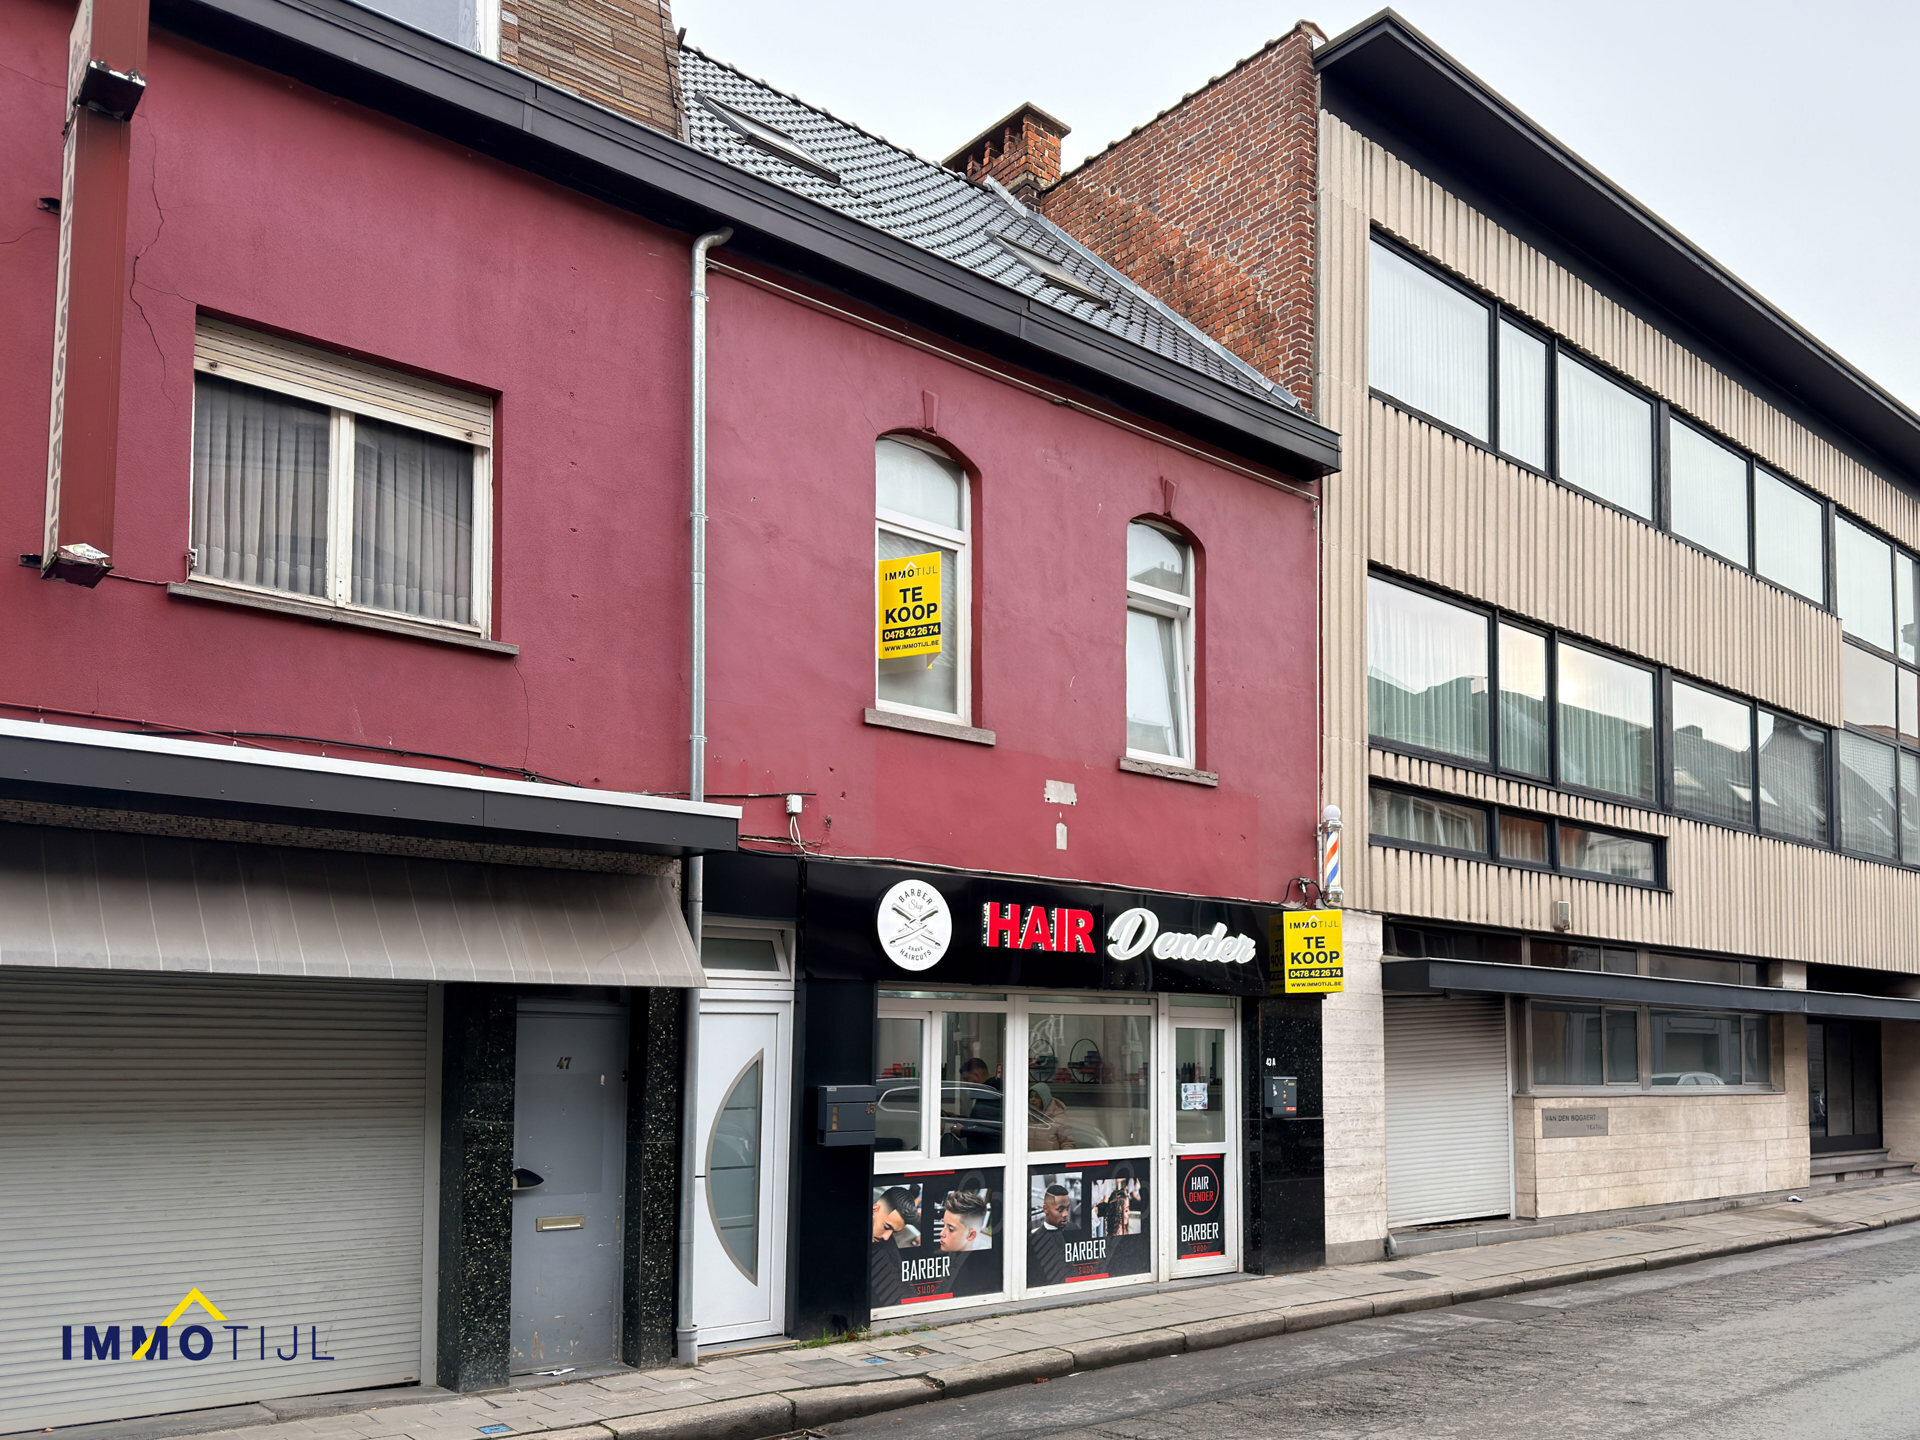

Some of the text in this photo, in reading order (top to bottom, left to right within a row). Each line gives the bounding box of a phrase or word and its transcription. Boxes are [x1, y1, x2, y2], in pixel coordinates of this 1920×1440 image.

[49, 127, 76, 565] PATISSERIE
[885, 565, 938, 581] IMMOTIJL
[899, 586, 923, 604] TE
[885, 602, 938, 624] KOOP
[884, 624, 939, 640] 0478 42 26 74
[884, 640, 939, 652] WWW.IMMOTIJL.BE
[898, 888, 933, 905] BARBER
[984, 901, 1256, 963] HAIR Dender
[1289, 920, 1340, 929] IMMOTIJL
[1303, 936, 1325, 949] TE
[900, 948, 932, 961] HAIRCUTS
[1290, 950, 1340, 965] KOOP
[1290, 969, 1309, 978] 0478
[1310, 969, 1320, 977] 42
[1320, 968, 1331, 977] 26
[1331, 968, 1341, 976] 74
[556, 1056, 572, 1070] 47
[1191, 1175, 1209, 1191] HAIR
[1188, 1190, 1214, 1203] DENDER
[1181, 1222, 1219, 1243] BARBER
[1065, 1239, 1107, 1262] BARBER
[901, 1256, 951, 1282] BARBER
[917, 1285, 936, 1296] SHOP
